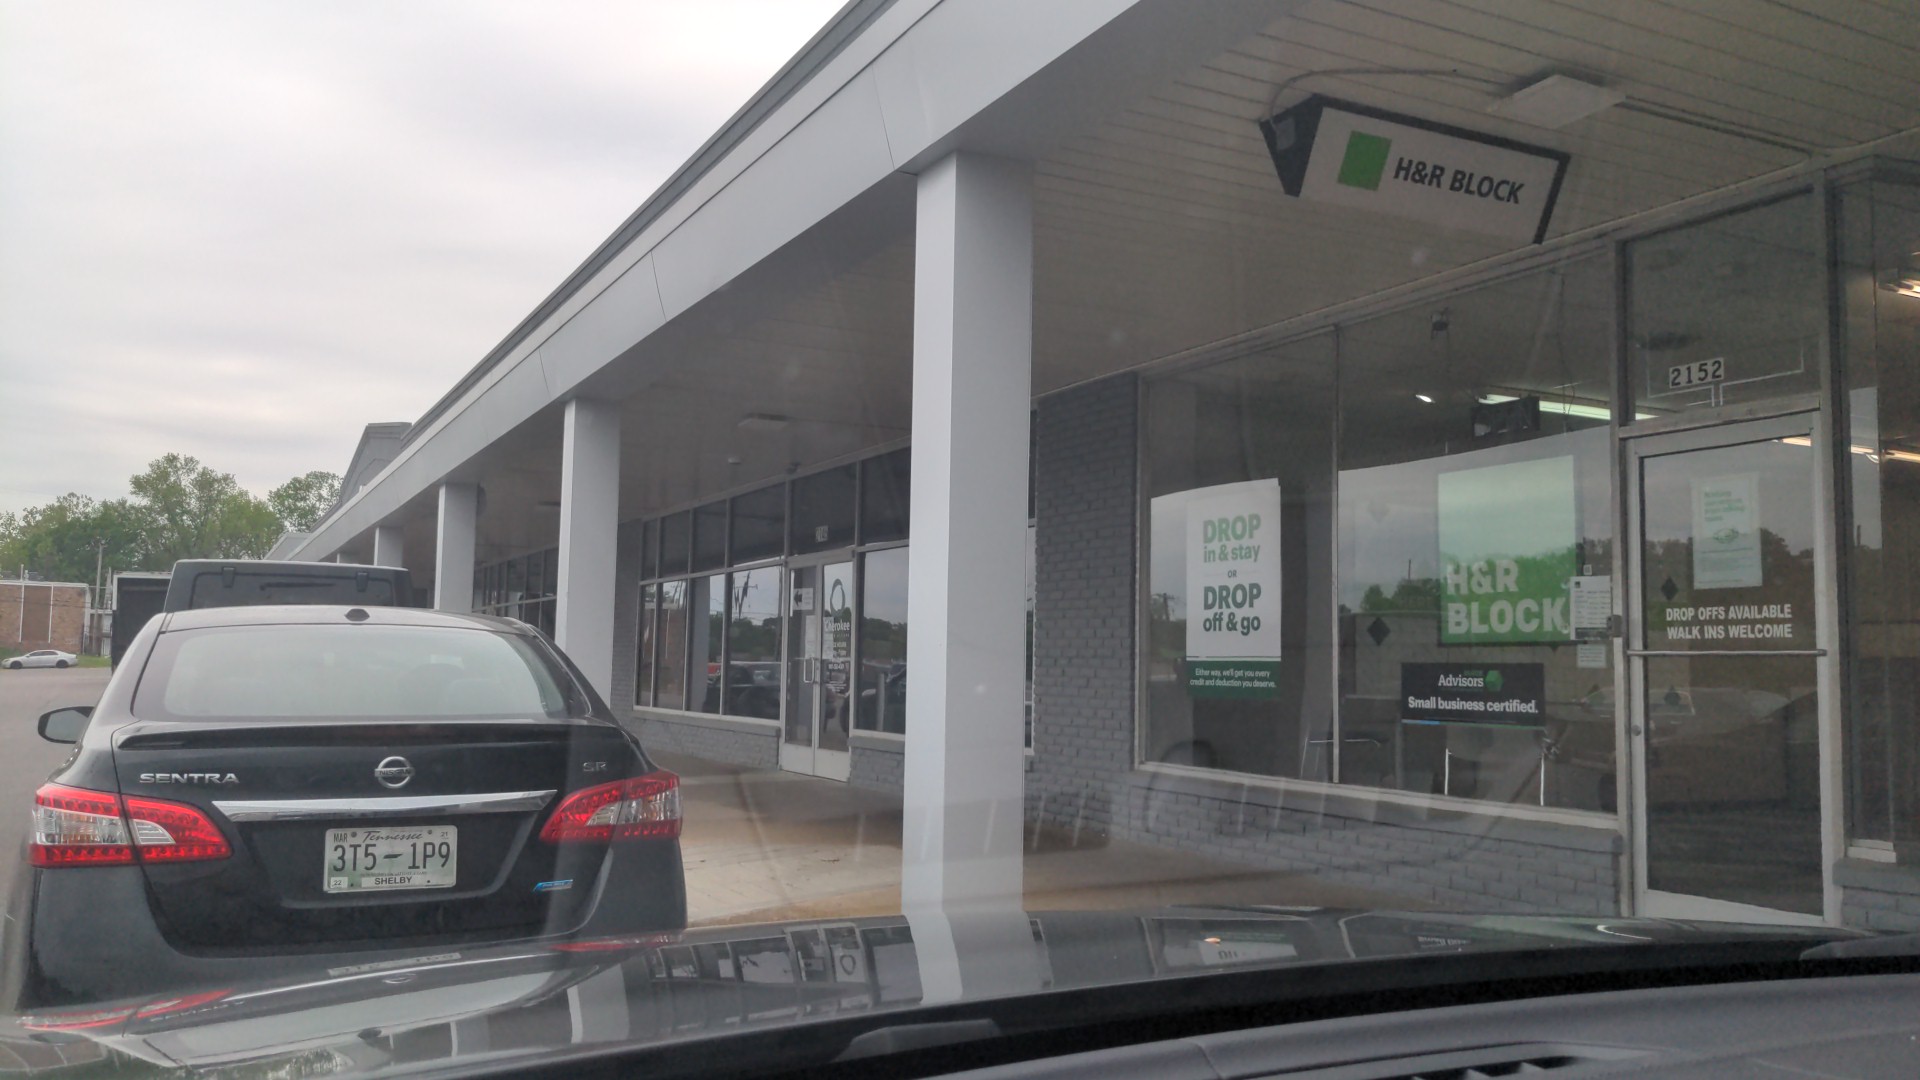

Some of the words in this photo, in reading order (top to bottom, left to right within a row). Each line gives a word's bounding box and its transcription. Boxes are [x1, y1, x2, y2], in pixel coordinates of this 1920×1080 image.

[1393, 157, 1444, 189] H&R
[1449, 169, 1525, 204] BLOCK
[1670, 360, 1723, 387] 2152
[1204, 513, 1261, 543] DROP
[1203, 545, 1216, 563] in
[1218, 545, 1229, 561] &
[1231, 544, 1261, 563] stay
[1227, 569, 1237, 578] OR
[1447, 559, 1519, 595] H&R
[1203, 583, 1262, 611] DROP
[1447, 597, 1567, 634] BLOCK
[1666, 607, 1695, 621] DROP
[1698, 606, 1725, 621] OFFS
[1728, 604, 1792, 620] AVAILABLE
[1203, 612, 1224, 633] off
[1226, 612, 1239, 632] &
[1241, 614, 1261, 636] go
[1666, 626, 1702, 640] WALK
[1704, 625, 1725, 639] INS
[1728, 623, 1792, 639] WELCOME
[1195, 668, 1210, 676] Either
[1234, 669, 1244, 678] get
[1244, 670, 1254, 678] you
[1255, 671, 1271, 679] every
[1438, 674, 1484, 687] Advisors
[1189, 678, 1204, 686] credit
[1204, 678, 1214, 686] and
[1215, 678, 1242, 687] deduction
[1242, 680, 1252, 688] you
[1408, 696, 1436, 709] Small
[1438, 697, 1485, 711] business
[1486, 699, 1539, 714] certified.
[379, 768, 411, 776] NISSAN
[583, 762, 606, 772] SR
[139, 773, 240, 784] SENTRA
[333, 832, 348, 843] MAR
[362, 830, 424, 844] Tennessee
[374, 876, 413, 886] SHELBY
